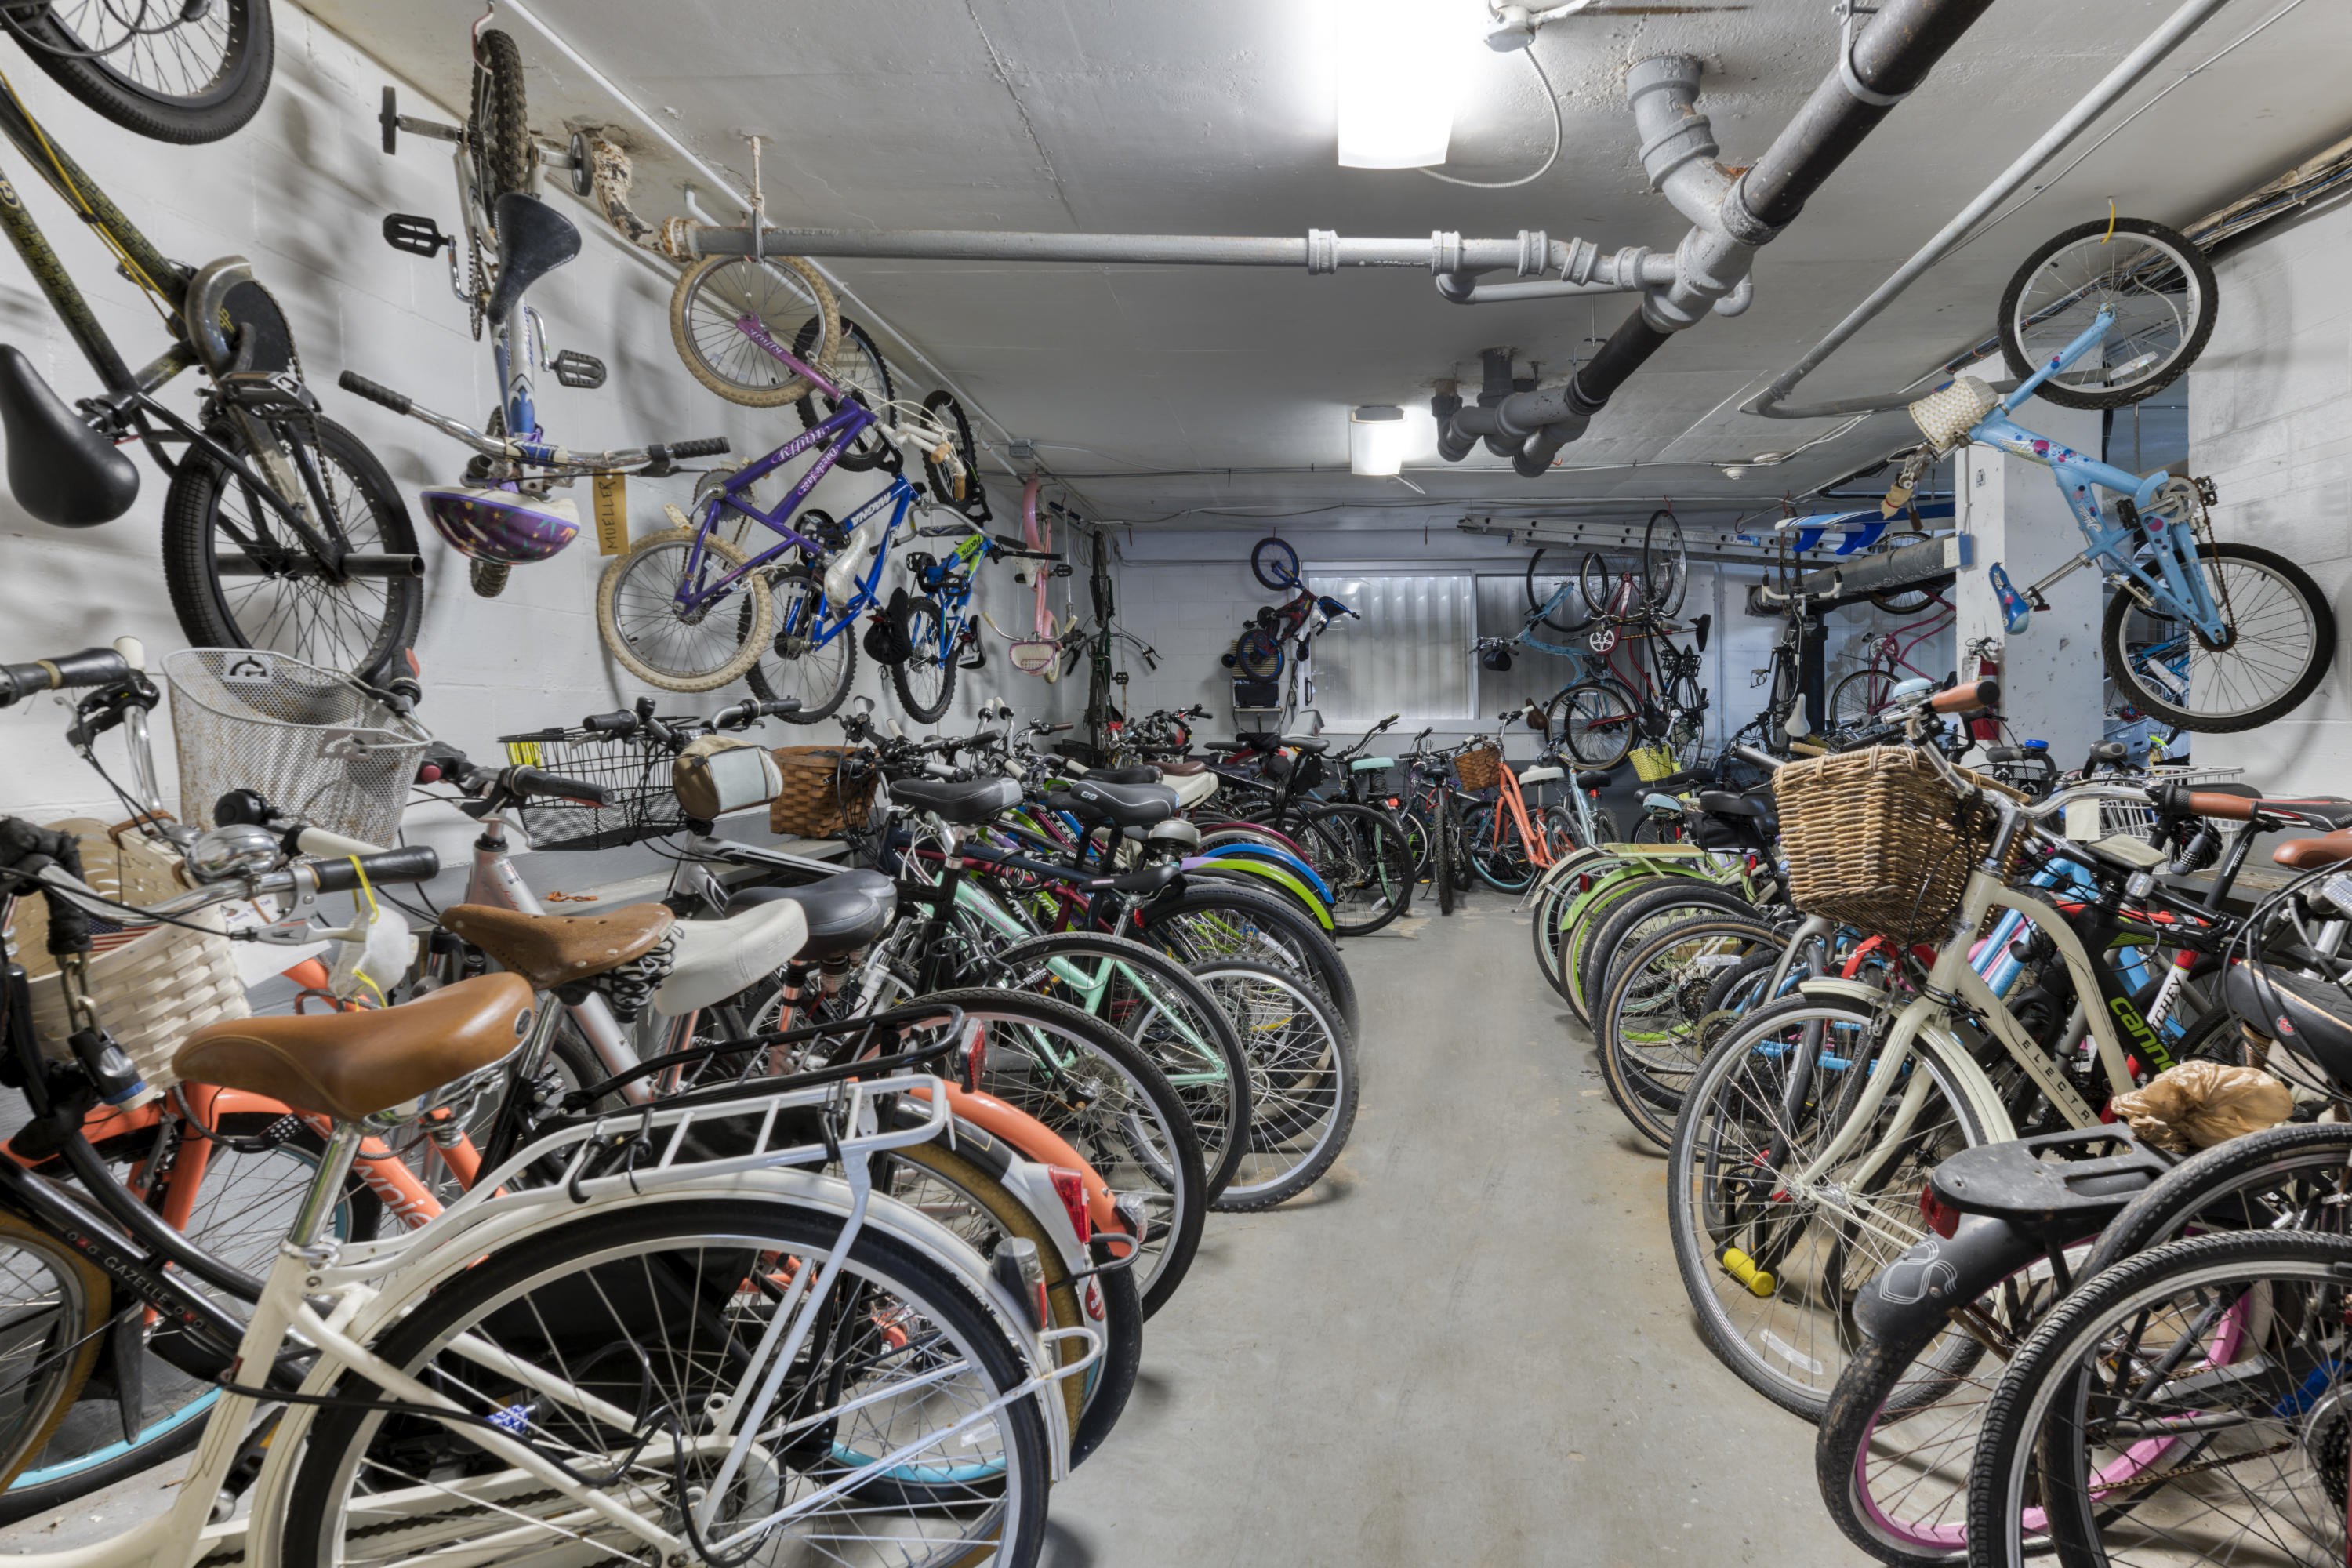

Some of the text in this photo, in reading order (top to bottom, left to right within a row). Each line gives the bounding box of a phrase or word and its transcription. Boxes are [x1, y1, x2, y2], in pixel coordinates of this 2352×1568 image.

[598, 481, 618, 549] MUELLER
[851, 492, 891, 527] MAGNA
[2233, 841, 2248, 867] RITCHEY
[2022, 1039, 2090, 1120] ELECTR
[104, 1256, 170, 1305] GAZELLE
